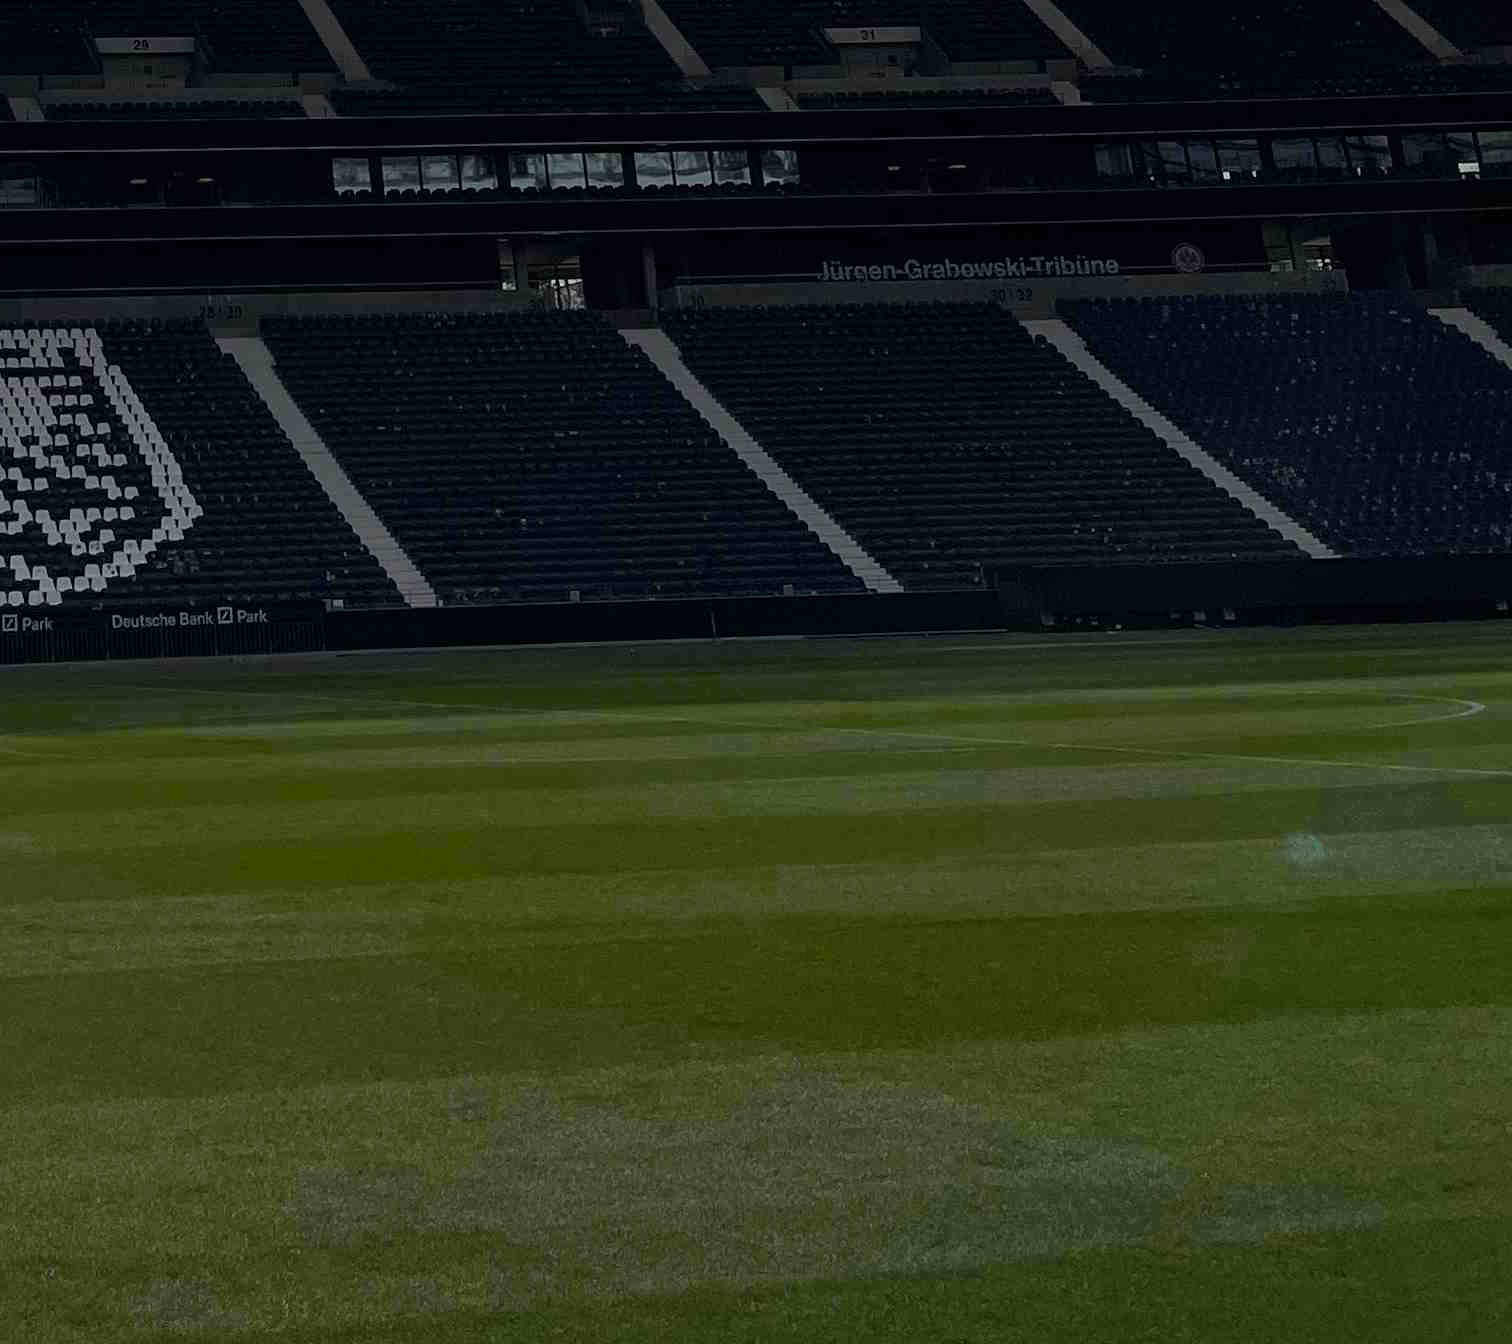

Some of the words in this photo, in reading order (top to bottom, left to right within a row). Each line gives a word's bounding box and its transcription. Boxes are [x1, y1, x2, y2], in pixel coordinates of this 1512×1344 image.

[860, 28, 875, 41] 31
[817, 255, 1120, 282] Jürgen-Grabowski-Tribüne
[22, 616, 54, 631] Park
[112, 613, 177, 629] Deutsche
[179, 611, 215, 627] Bank
[238, 609, 269, 624] Park
